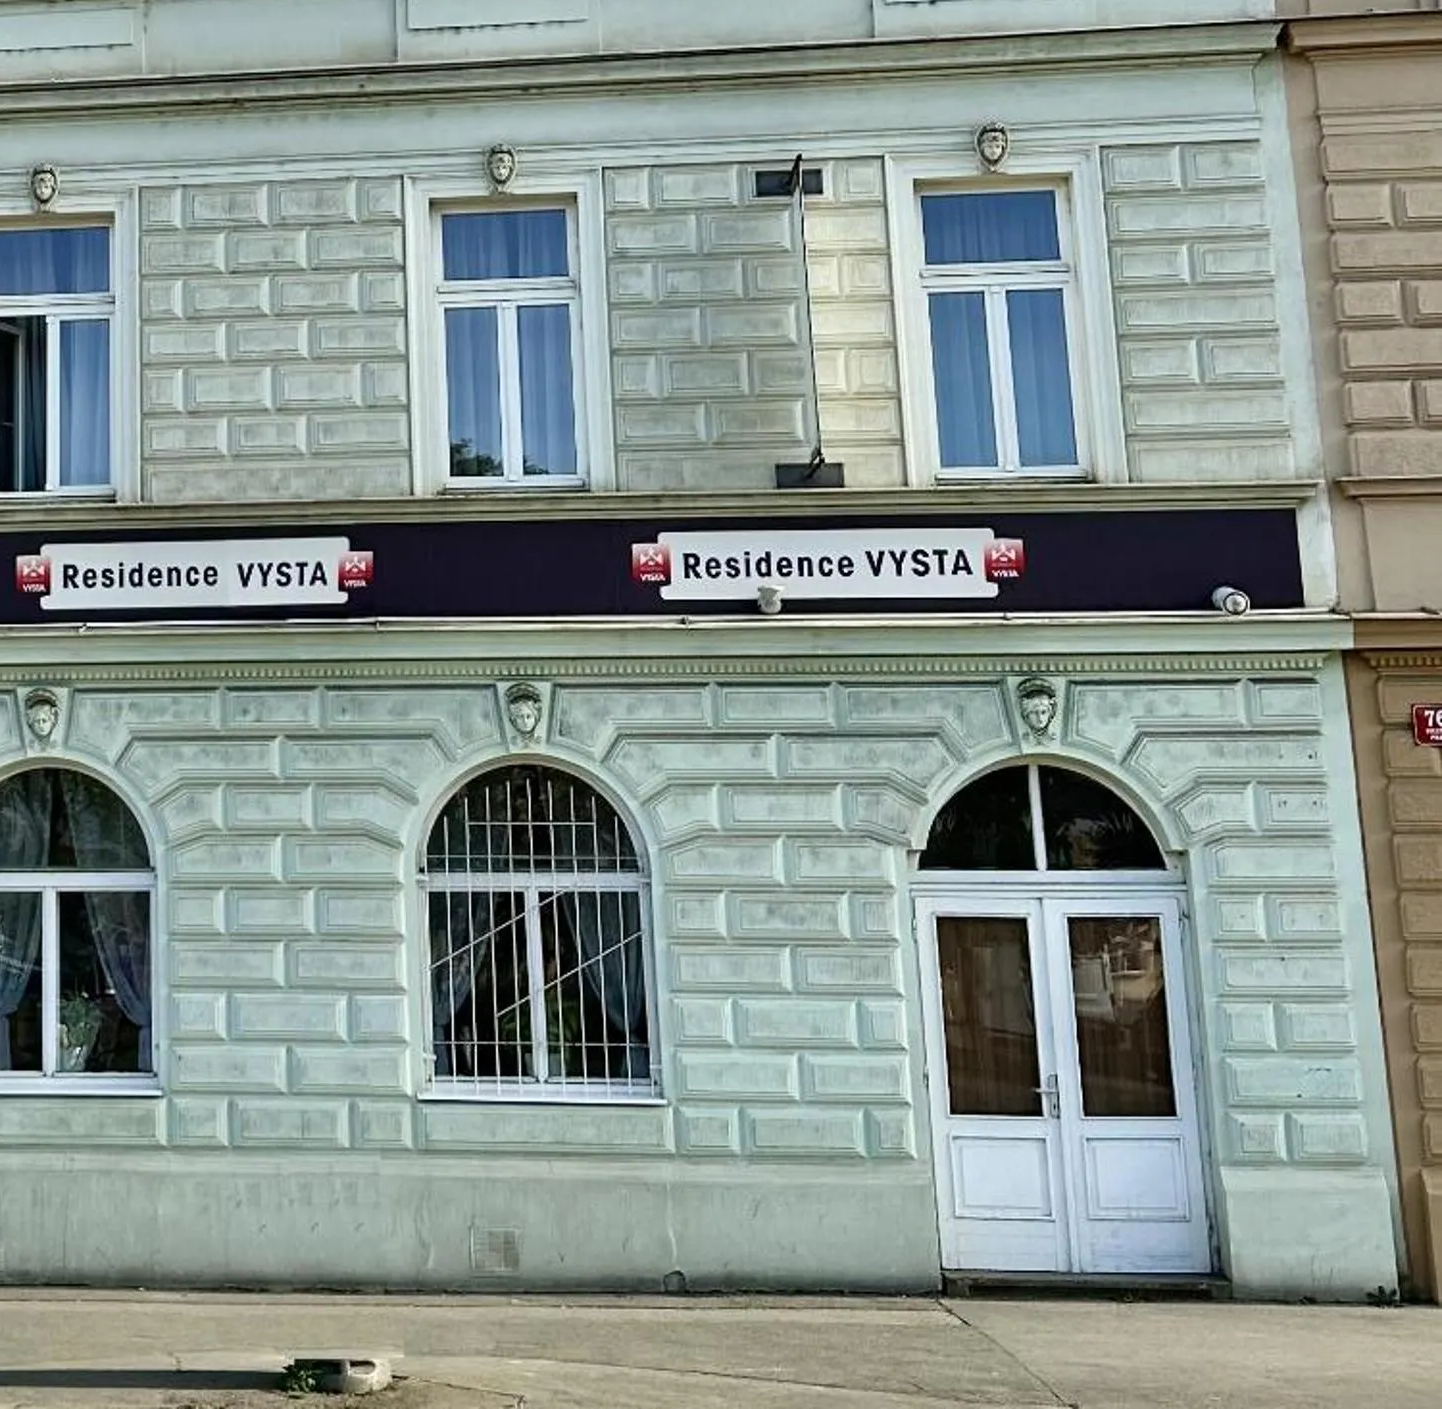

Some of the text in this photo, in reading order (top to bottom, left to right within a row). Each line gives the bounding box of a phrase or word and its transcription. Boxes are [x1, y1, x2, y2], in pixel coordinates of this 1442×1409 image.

[61, 561, 328, 589] Residence VYSTA
[682, 548, 974, 579] Residence VYSTA
